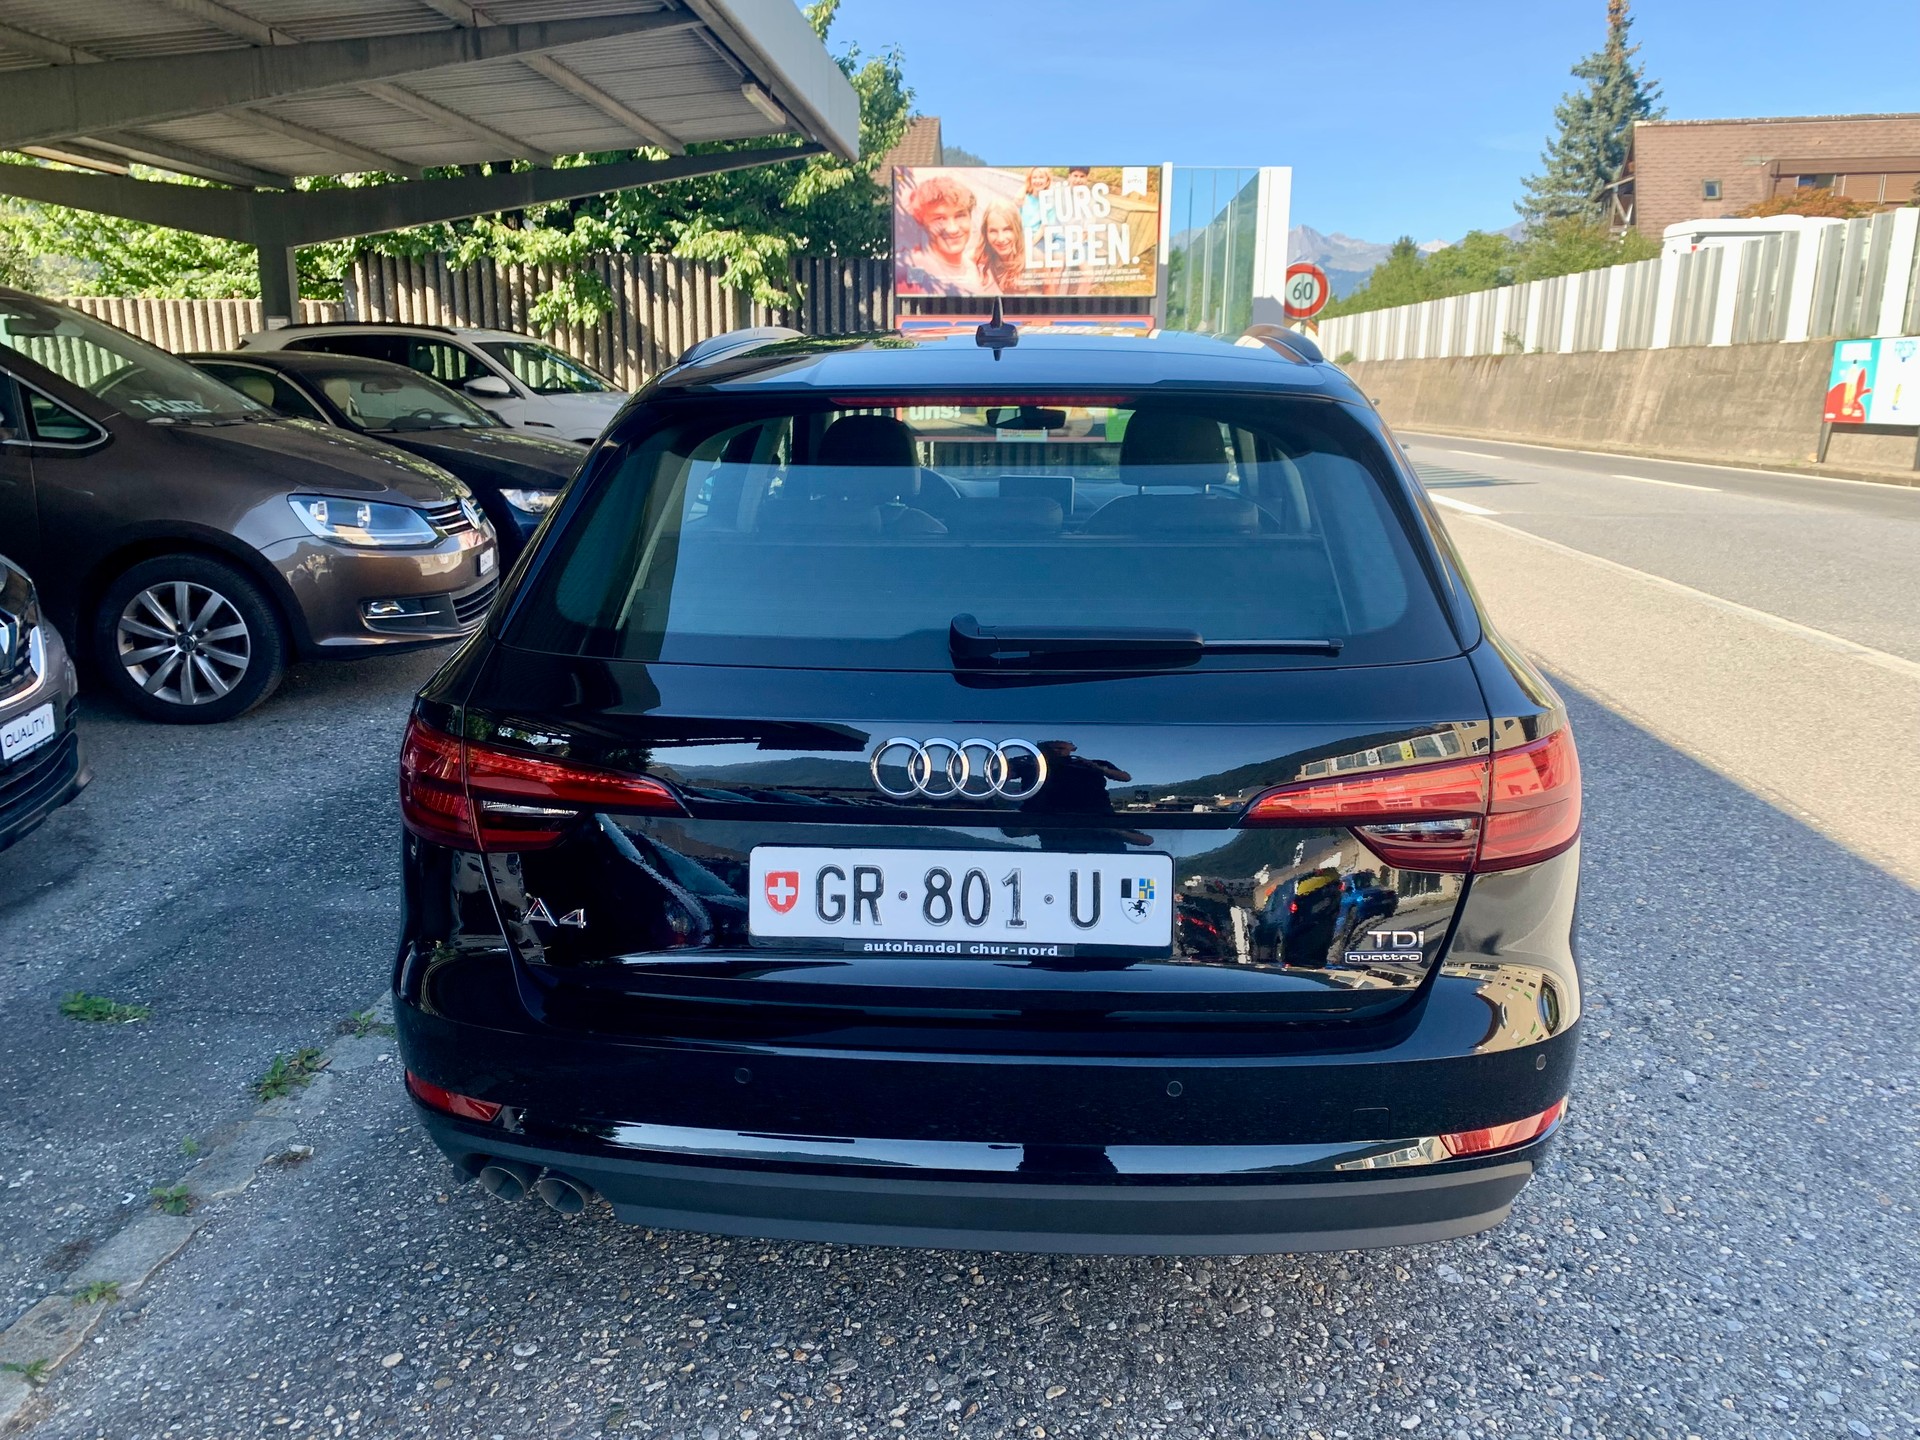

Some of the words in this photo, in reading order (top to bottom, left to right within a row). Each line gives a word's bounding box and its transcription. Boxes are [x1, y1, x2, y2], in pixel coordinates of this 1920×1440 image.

[1038, 180, 1112, 224] FÜRS
[1023, 222, 1141, 269] LEBEN.
[1292, 281, 1314, 301] 60
[522, 898, 587, 929] A4
[863, 941, 962, 954] autohandel
[969, 943, 1059, 957] chur-nord
[1367, 931, 1425, 949] TDI
[1348, 952, 1420, 963] quattro
